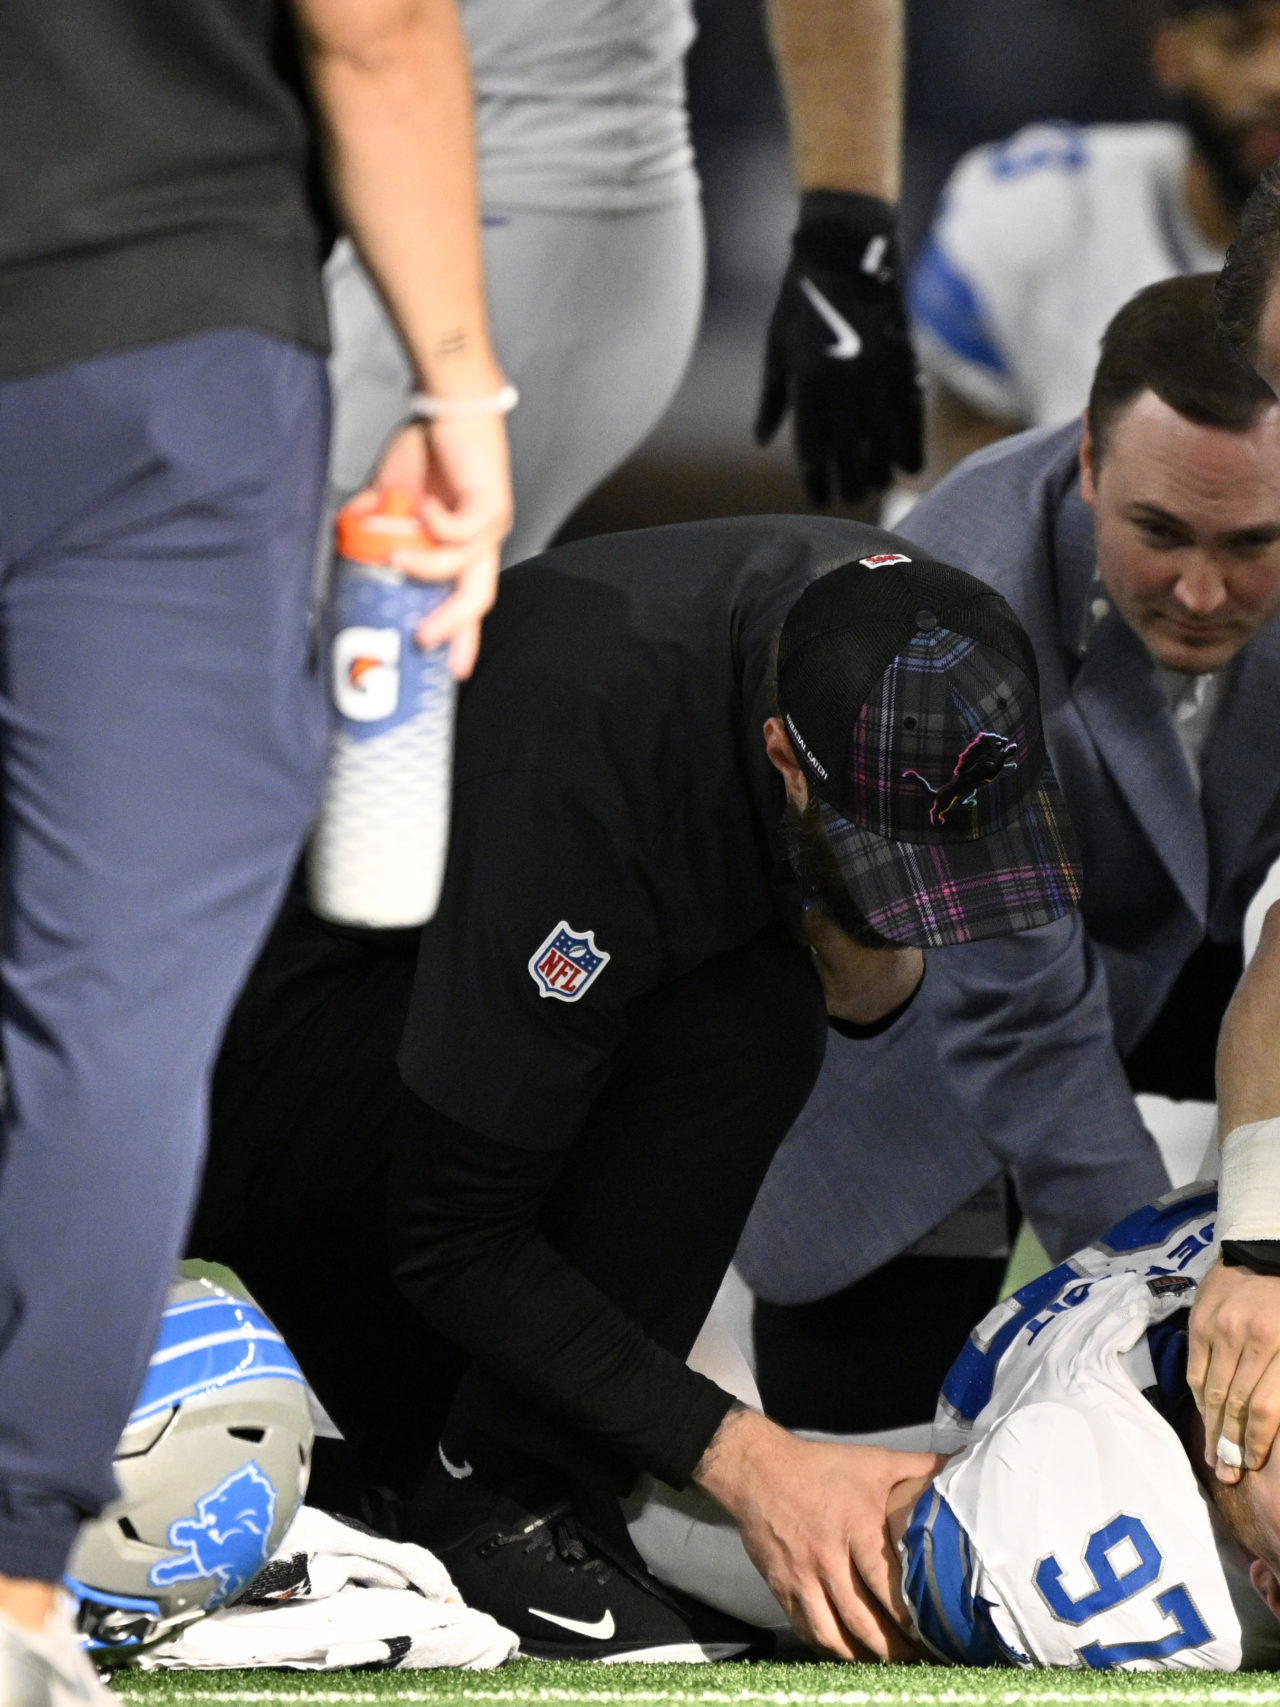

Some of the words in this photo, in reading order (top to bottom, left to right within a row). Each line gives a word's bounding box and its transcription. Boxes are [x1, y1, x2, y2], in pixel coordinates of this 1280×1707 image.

[332, 627, 400, 721] G
[807, 750, 829, 780] CATCH
[539, 948, 582, 993] NFL
[1031, 1510, 1217, 1671] 97
